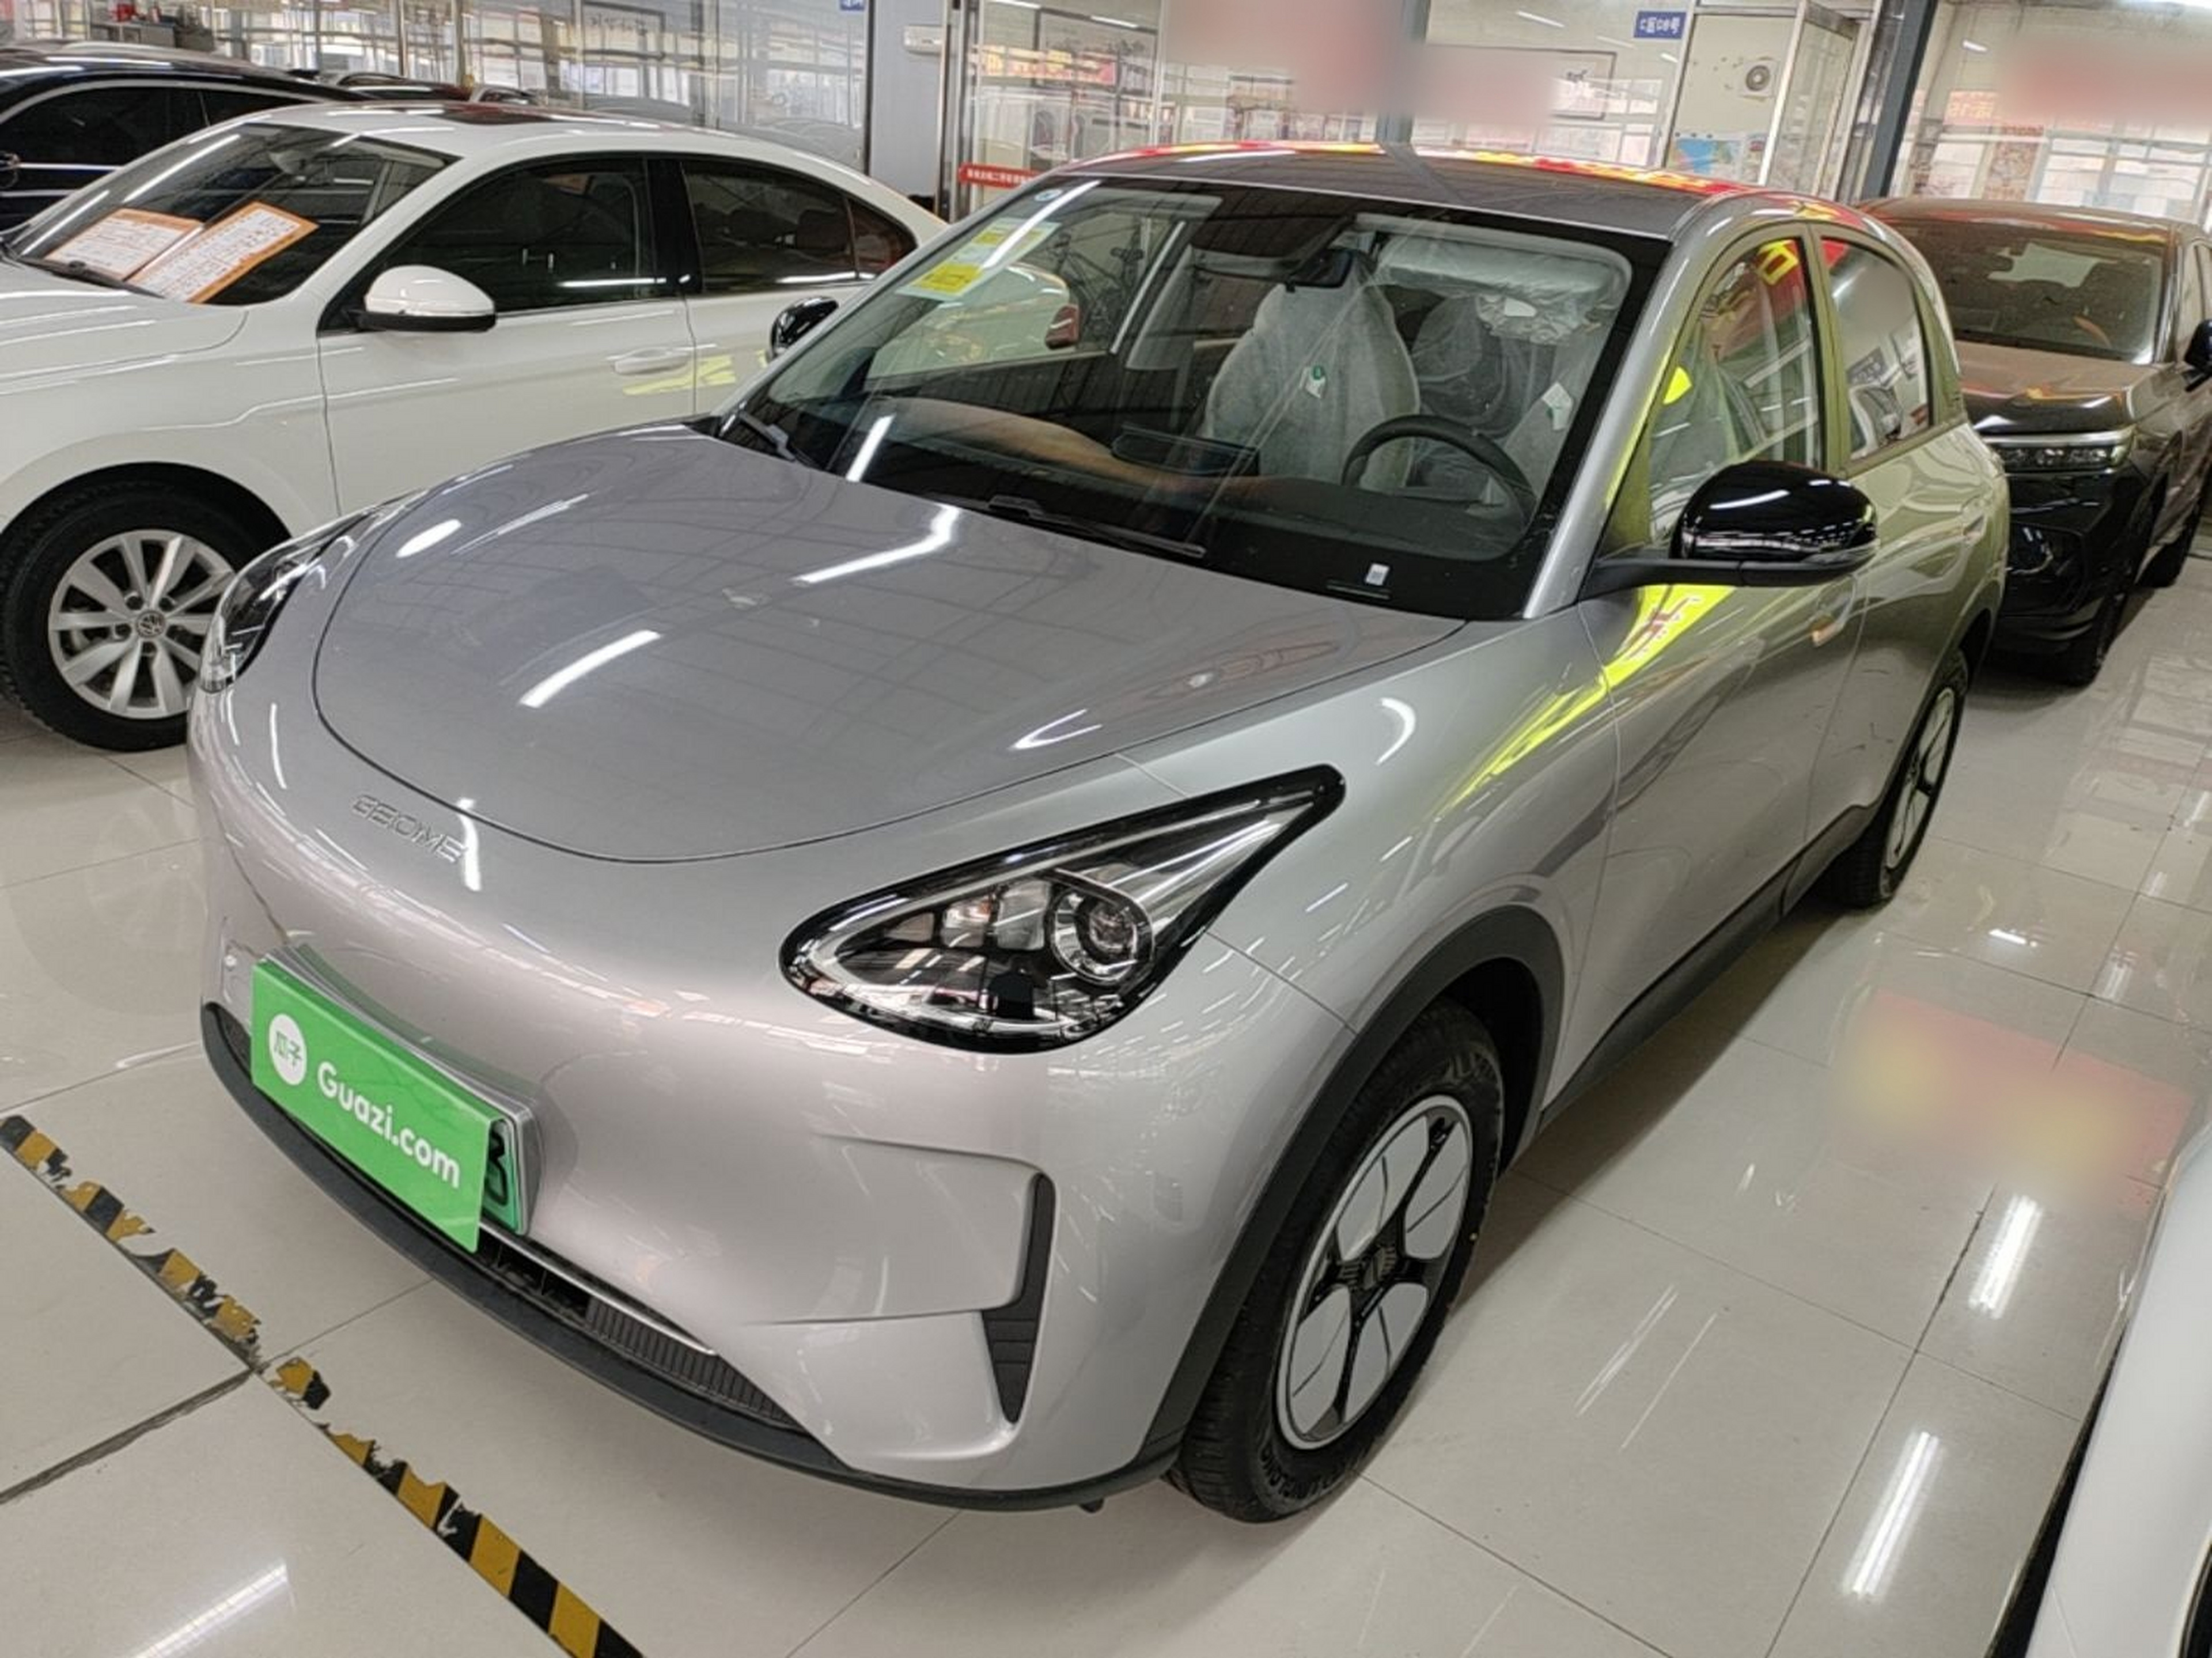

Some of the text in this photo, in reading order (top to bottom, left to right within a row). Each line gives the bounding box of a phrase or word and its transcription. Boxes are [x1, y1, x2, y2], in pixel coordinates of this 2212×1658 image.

[353, 794, 468, 863] GEOME
[274, 1030, 303, 1069] 瓜子
[317, 1062, 460, 1189] Guazi.com
